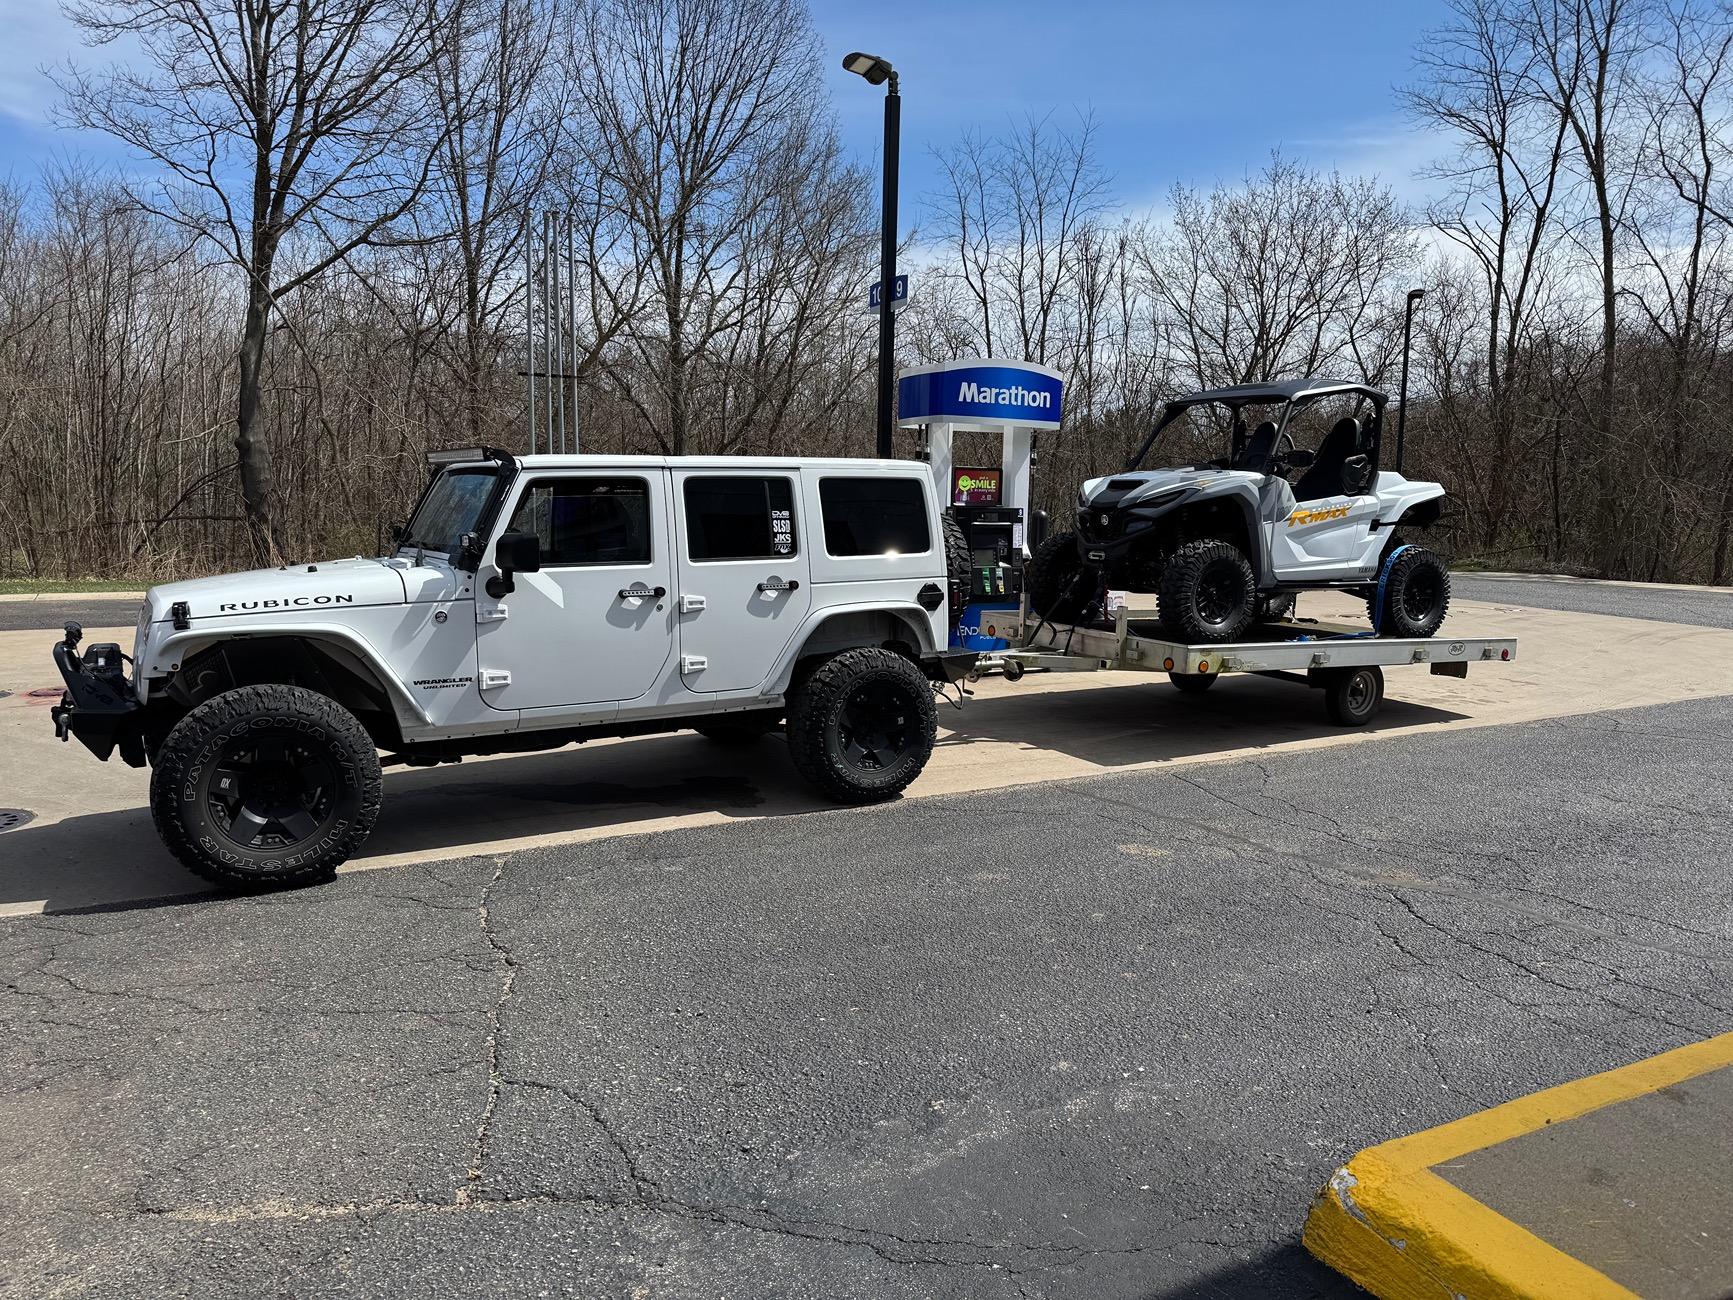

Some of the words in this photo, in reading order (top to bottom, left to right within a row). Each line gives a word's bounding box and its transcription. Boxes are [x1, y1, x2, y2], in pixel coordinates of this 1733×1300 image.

[896, 280, 903, 297] 9
[958, 382, 1051, 408] Marathon
[971, 479, 996, 489] SMILE
[774, 533, 791, 543] JKS
[220, 594, 353, 612] RUBICON
[413, 677, 473, 685] WRANGLER
[183, 716, 326, 801] PATAGONIA
[329, 741, 358, 788] M/T
[199, 819, 349, 872] MILESTAR
